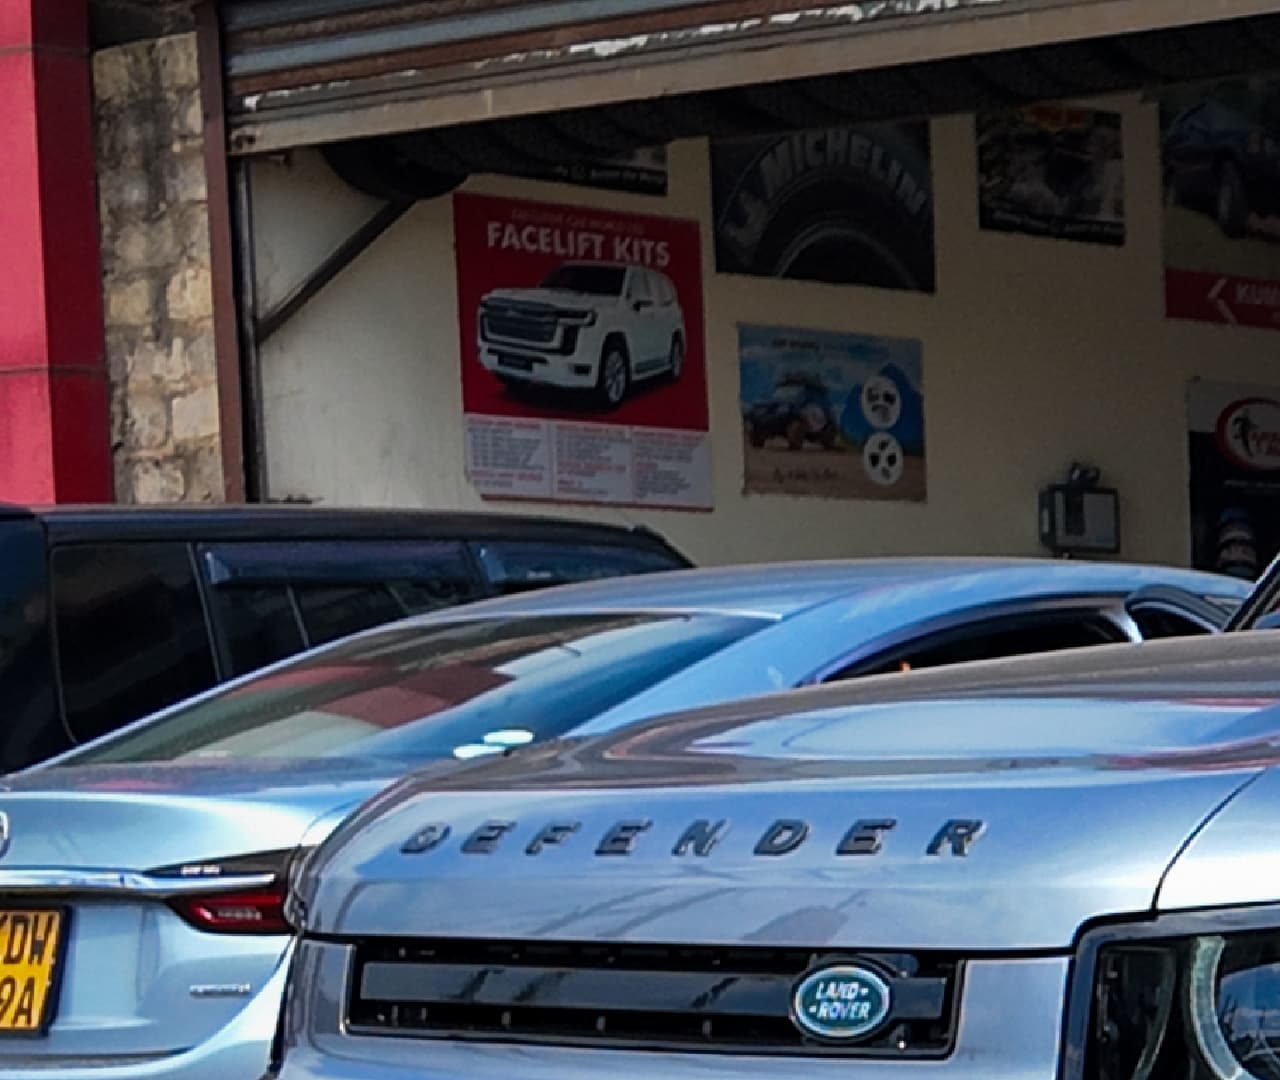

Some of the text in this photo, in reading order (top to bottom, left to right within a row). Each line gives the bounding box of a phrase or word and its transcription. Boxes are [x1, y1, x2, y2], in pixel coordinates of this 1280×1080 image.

[759, 127, 928, 215] MICHELIN
[486, 220, 604, 259] FACELIFT
[613, 236, 671, 268] KITS
[400, 818, 988, 857] DEFENDER
[0, 914, 54, 965] DW
